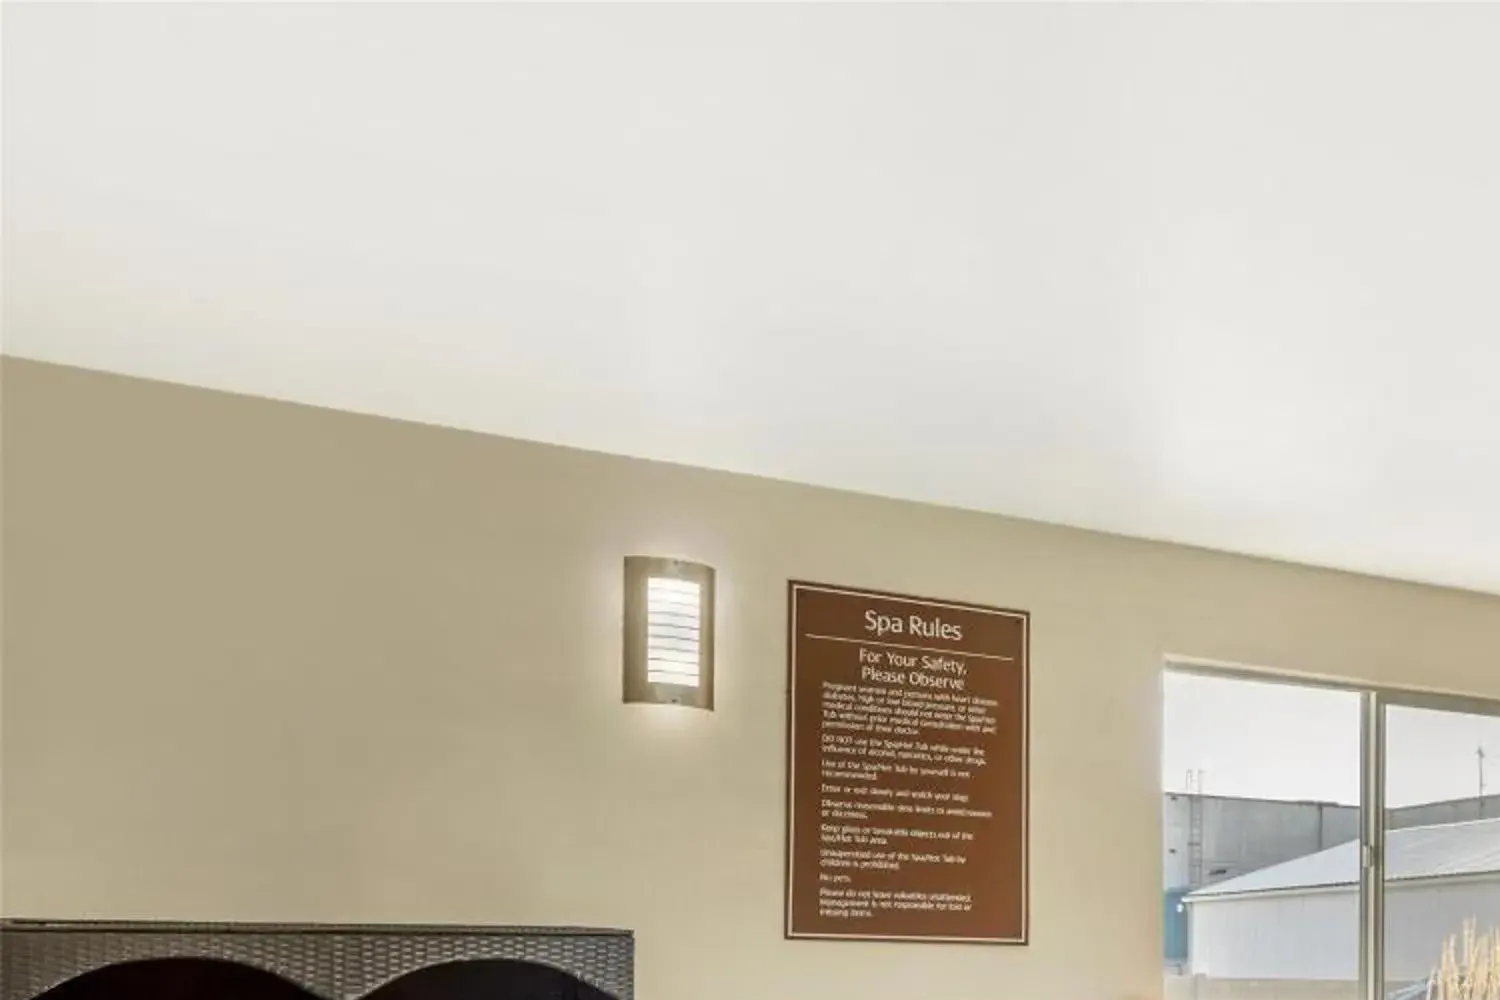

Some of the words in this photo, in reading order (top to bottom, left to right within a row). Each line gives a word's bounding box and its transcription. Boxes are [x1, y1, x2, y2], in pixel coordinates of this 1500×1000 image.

[865, 610, 902, 635] Spa
[909, 616, 963, 641] Rules
[859, 648, 881, 663] For
[887, 651, 918, 668] Your
[921, 655, 968, 675] Safety,
[862, 667, 905, 684] Please
[909, 673, 965, 690] Observe
